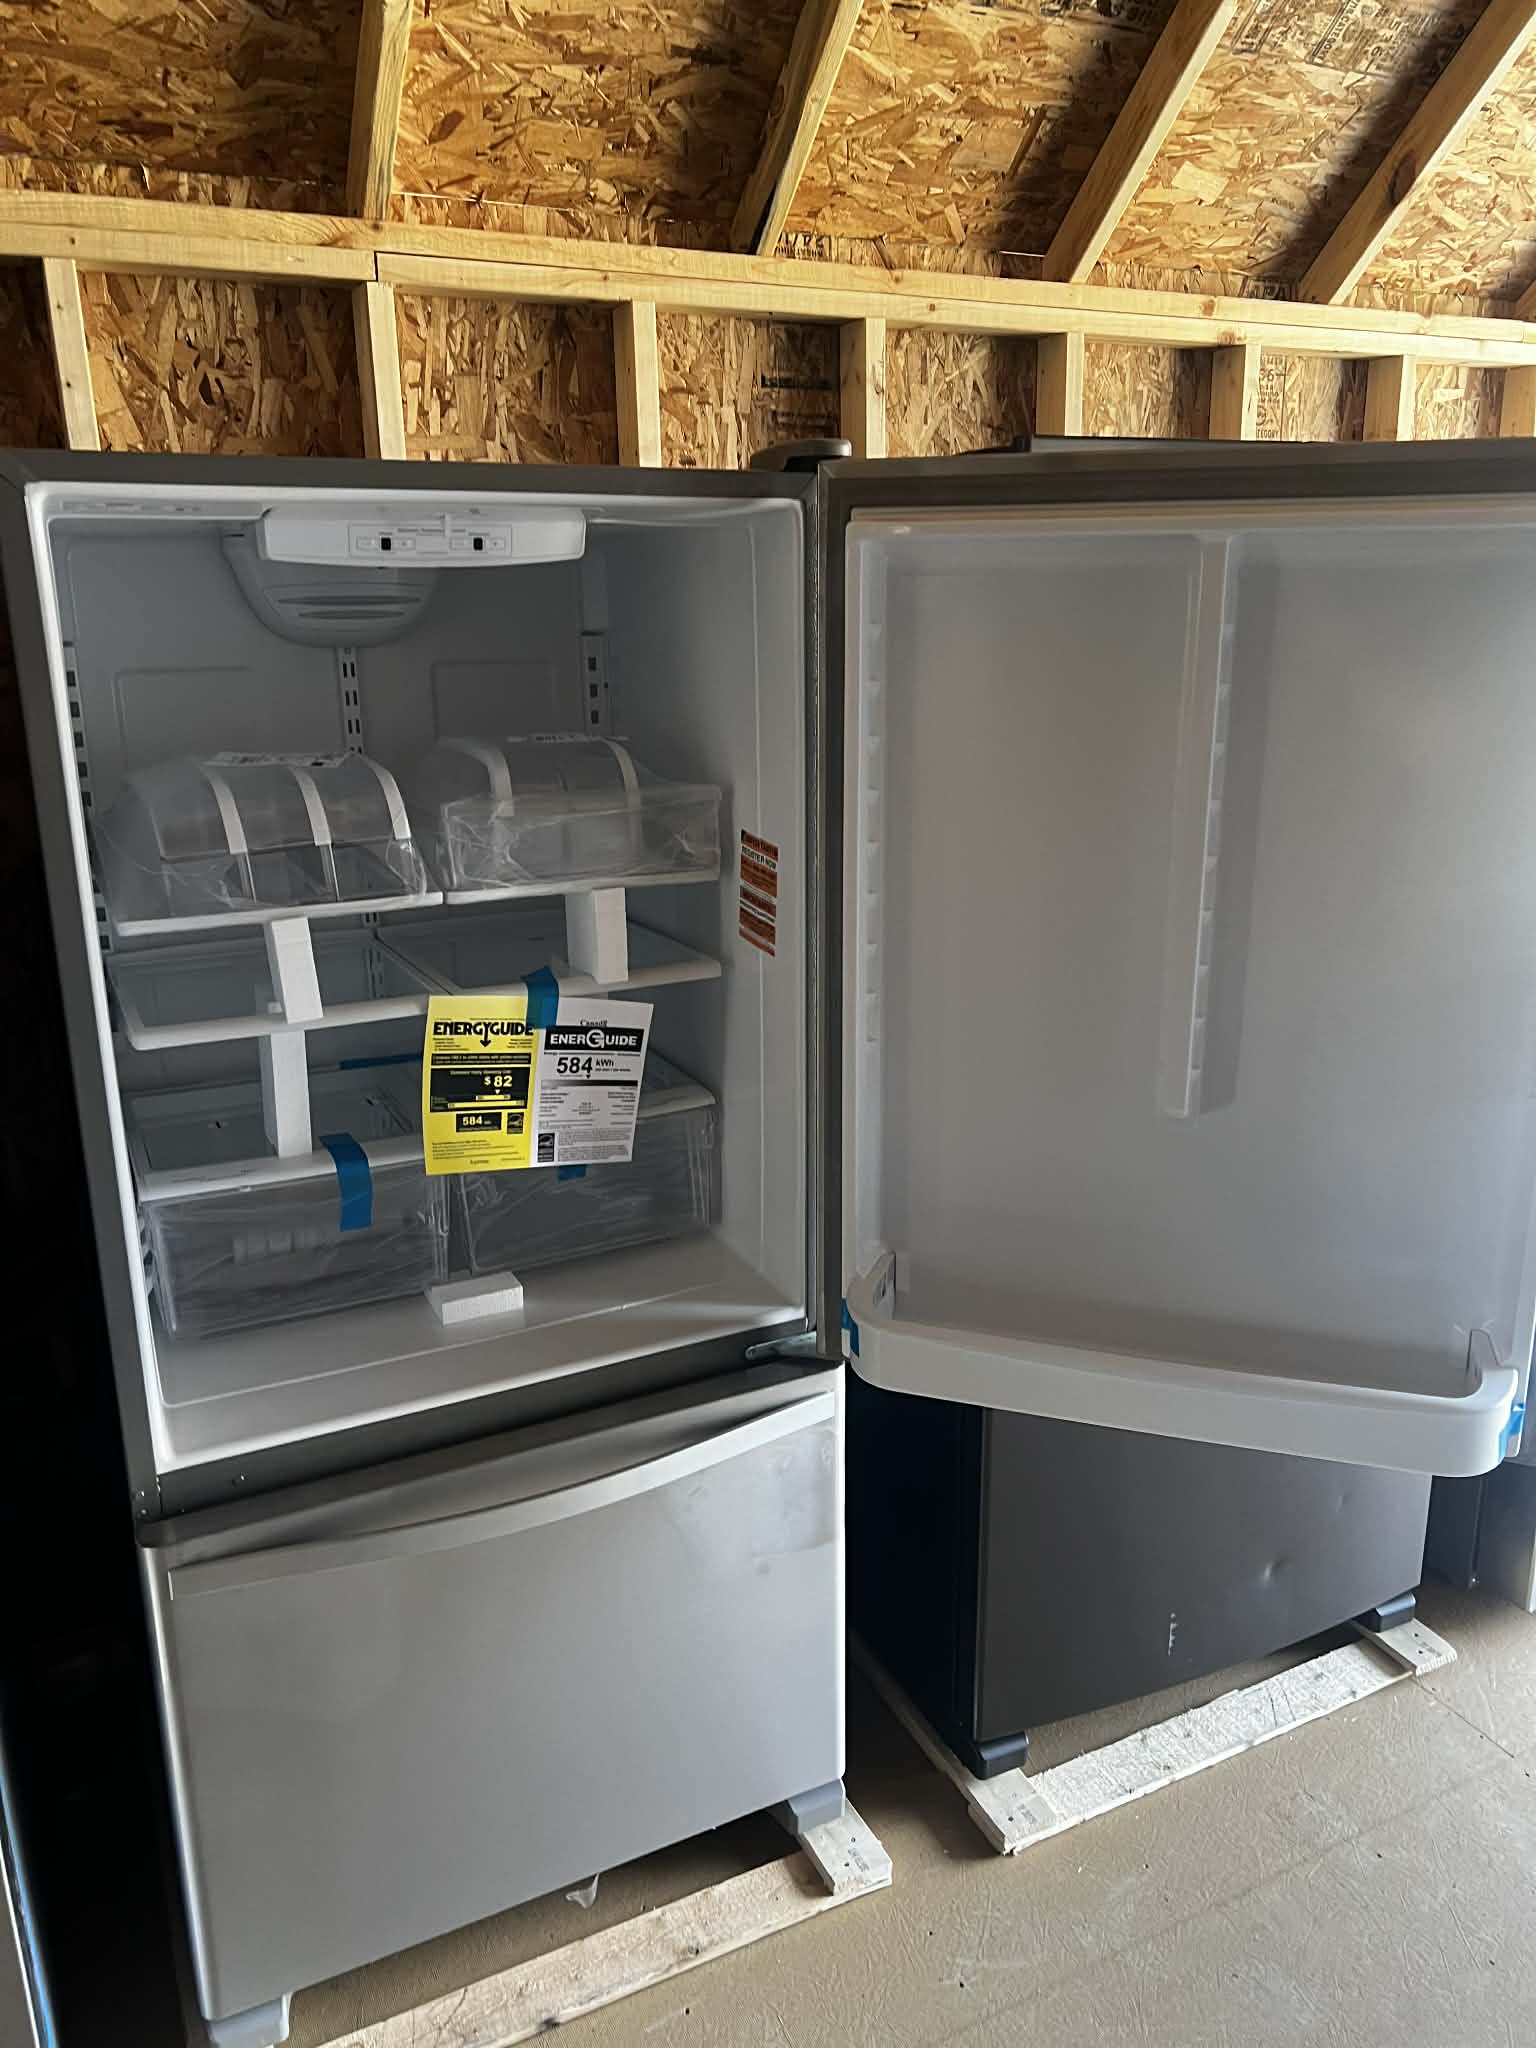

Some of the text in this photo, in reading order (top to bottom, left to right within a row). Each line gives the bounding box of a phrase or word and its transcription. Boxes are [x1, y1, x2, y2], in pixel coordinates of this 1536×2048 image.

[550, 1029, 638, 1049] ENERGUIDE
[556, 1056, 614, 1074] 584 kWh
